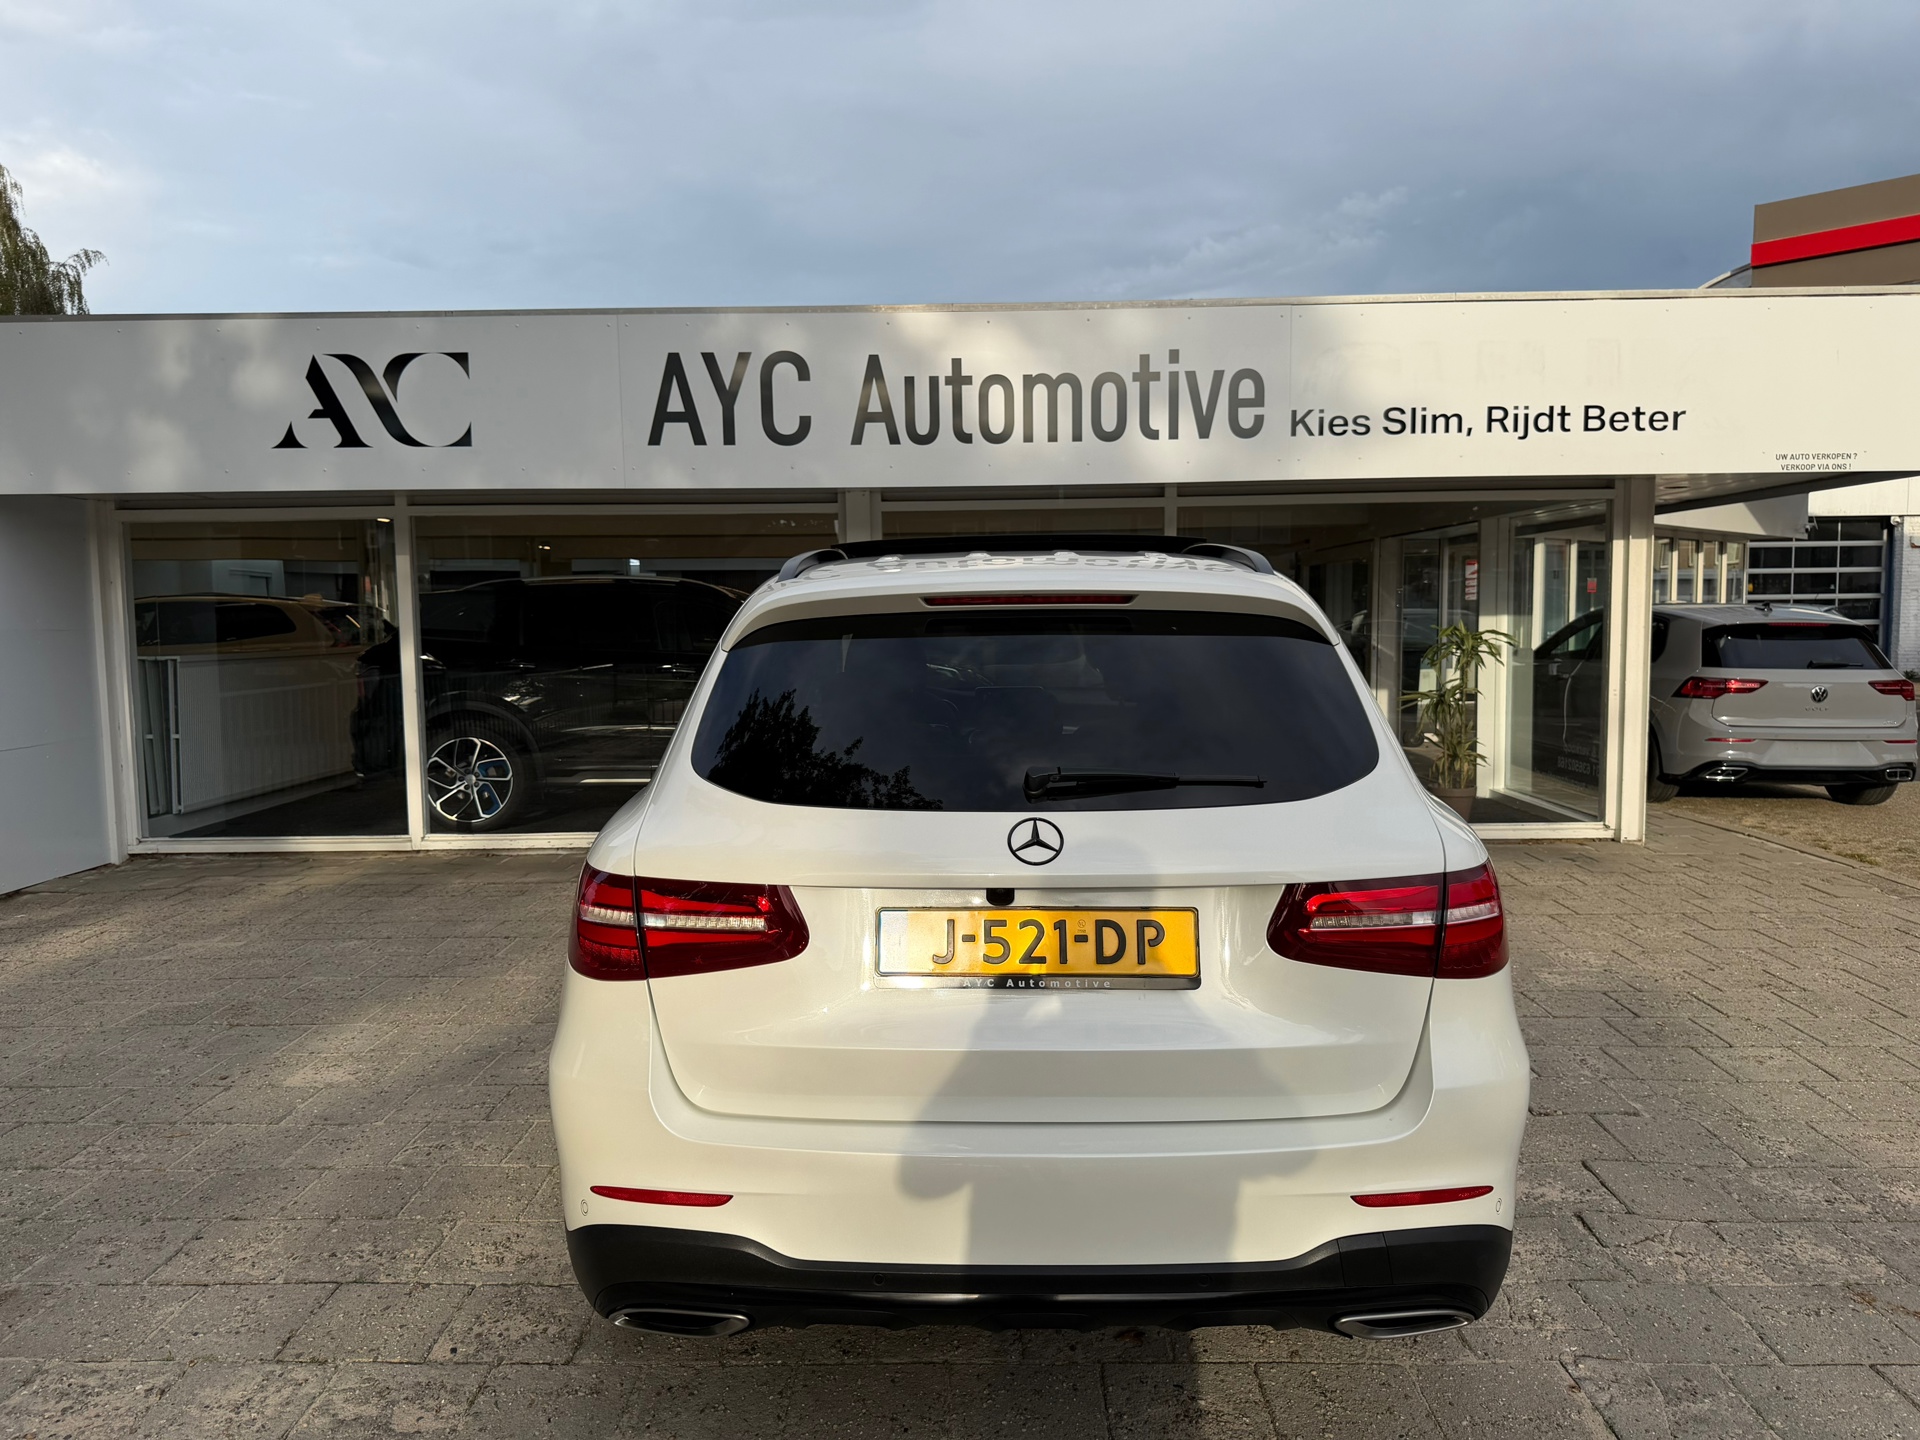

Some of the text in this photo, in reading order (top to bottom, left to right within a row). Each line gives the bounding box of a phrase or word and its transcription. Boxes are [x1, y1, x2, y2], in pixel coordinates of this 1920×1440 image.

[648, 349, 1265, 447] AYC Automotive
[1290, 404, 1687, 440] Kies Slim, Rijdt Beter
[1775, 452, 1858, 461] UW AUTO VERKOPEN ?
[1780, 463, 1816, 471] VERKOOP
[1817, 463, 1830, 471] VIA
[932, 918, 1166, 966] J-521-DP
[962, 978, 1111, 988] AYC Automotive
